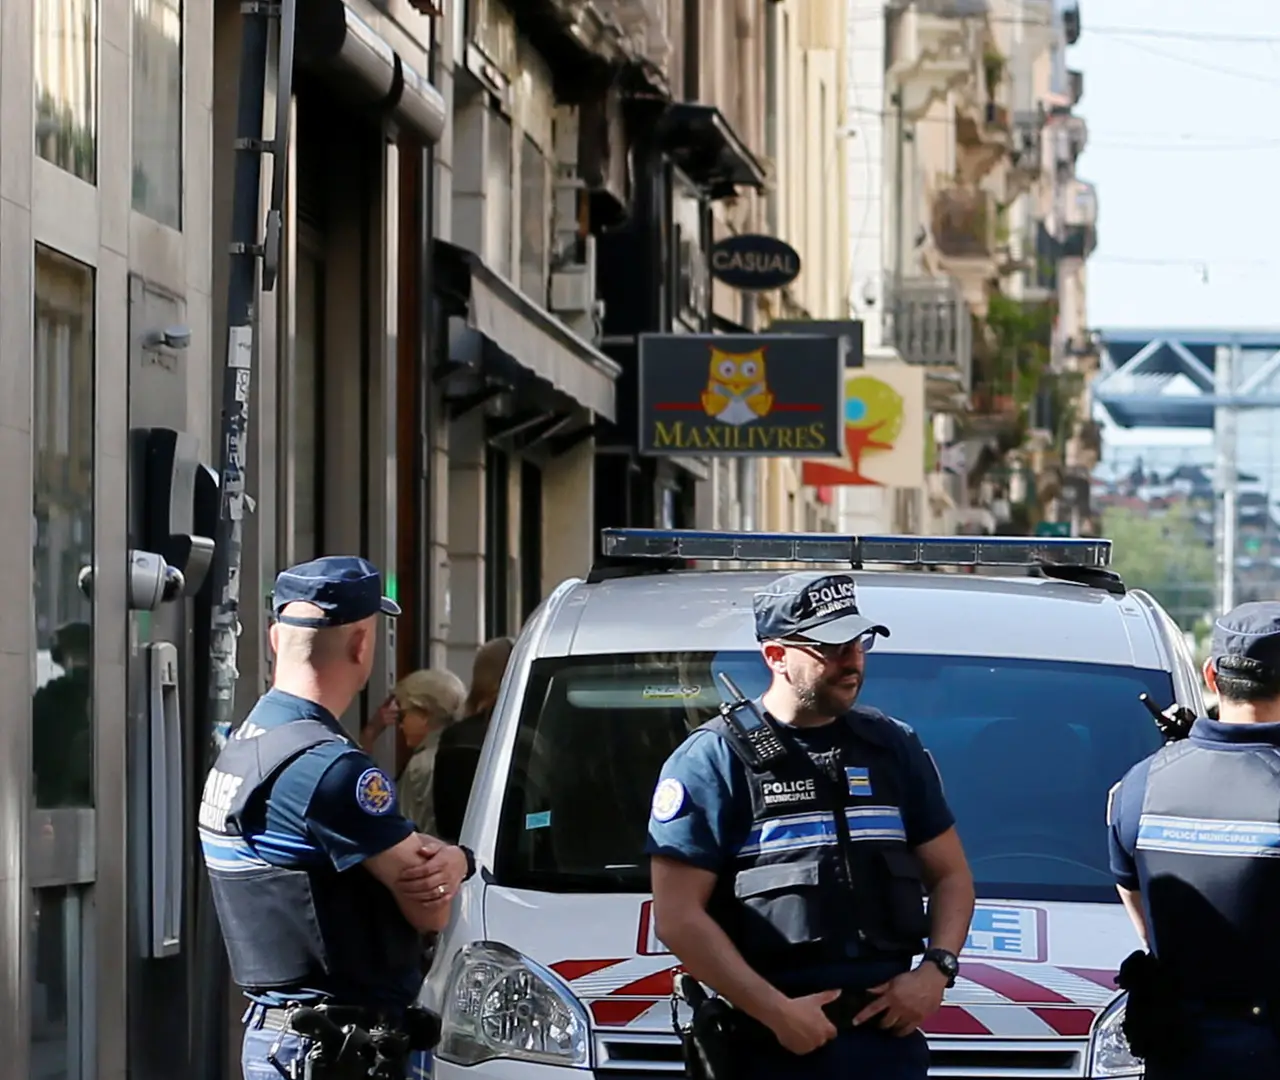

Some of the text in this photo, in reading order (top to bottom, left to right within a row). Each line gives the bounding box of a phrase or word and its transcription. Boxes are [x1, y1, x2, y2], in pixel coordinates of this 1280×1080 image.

[712, 251, 795, 274] CASUAL
[763, 778, 815, 795] POLICE
[764, 790, 817, 804] MUNICIPALE
[1162, 829, 1258, 844] POLICE MUNICIPALE
